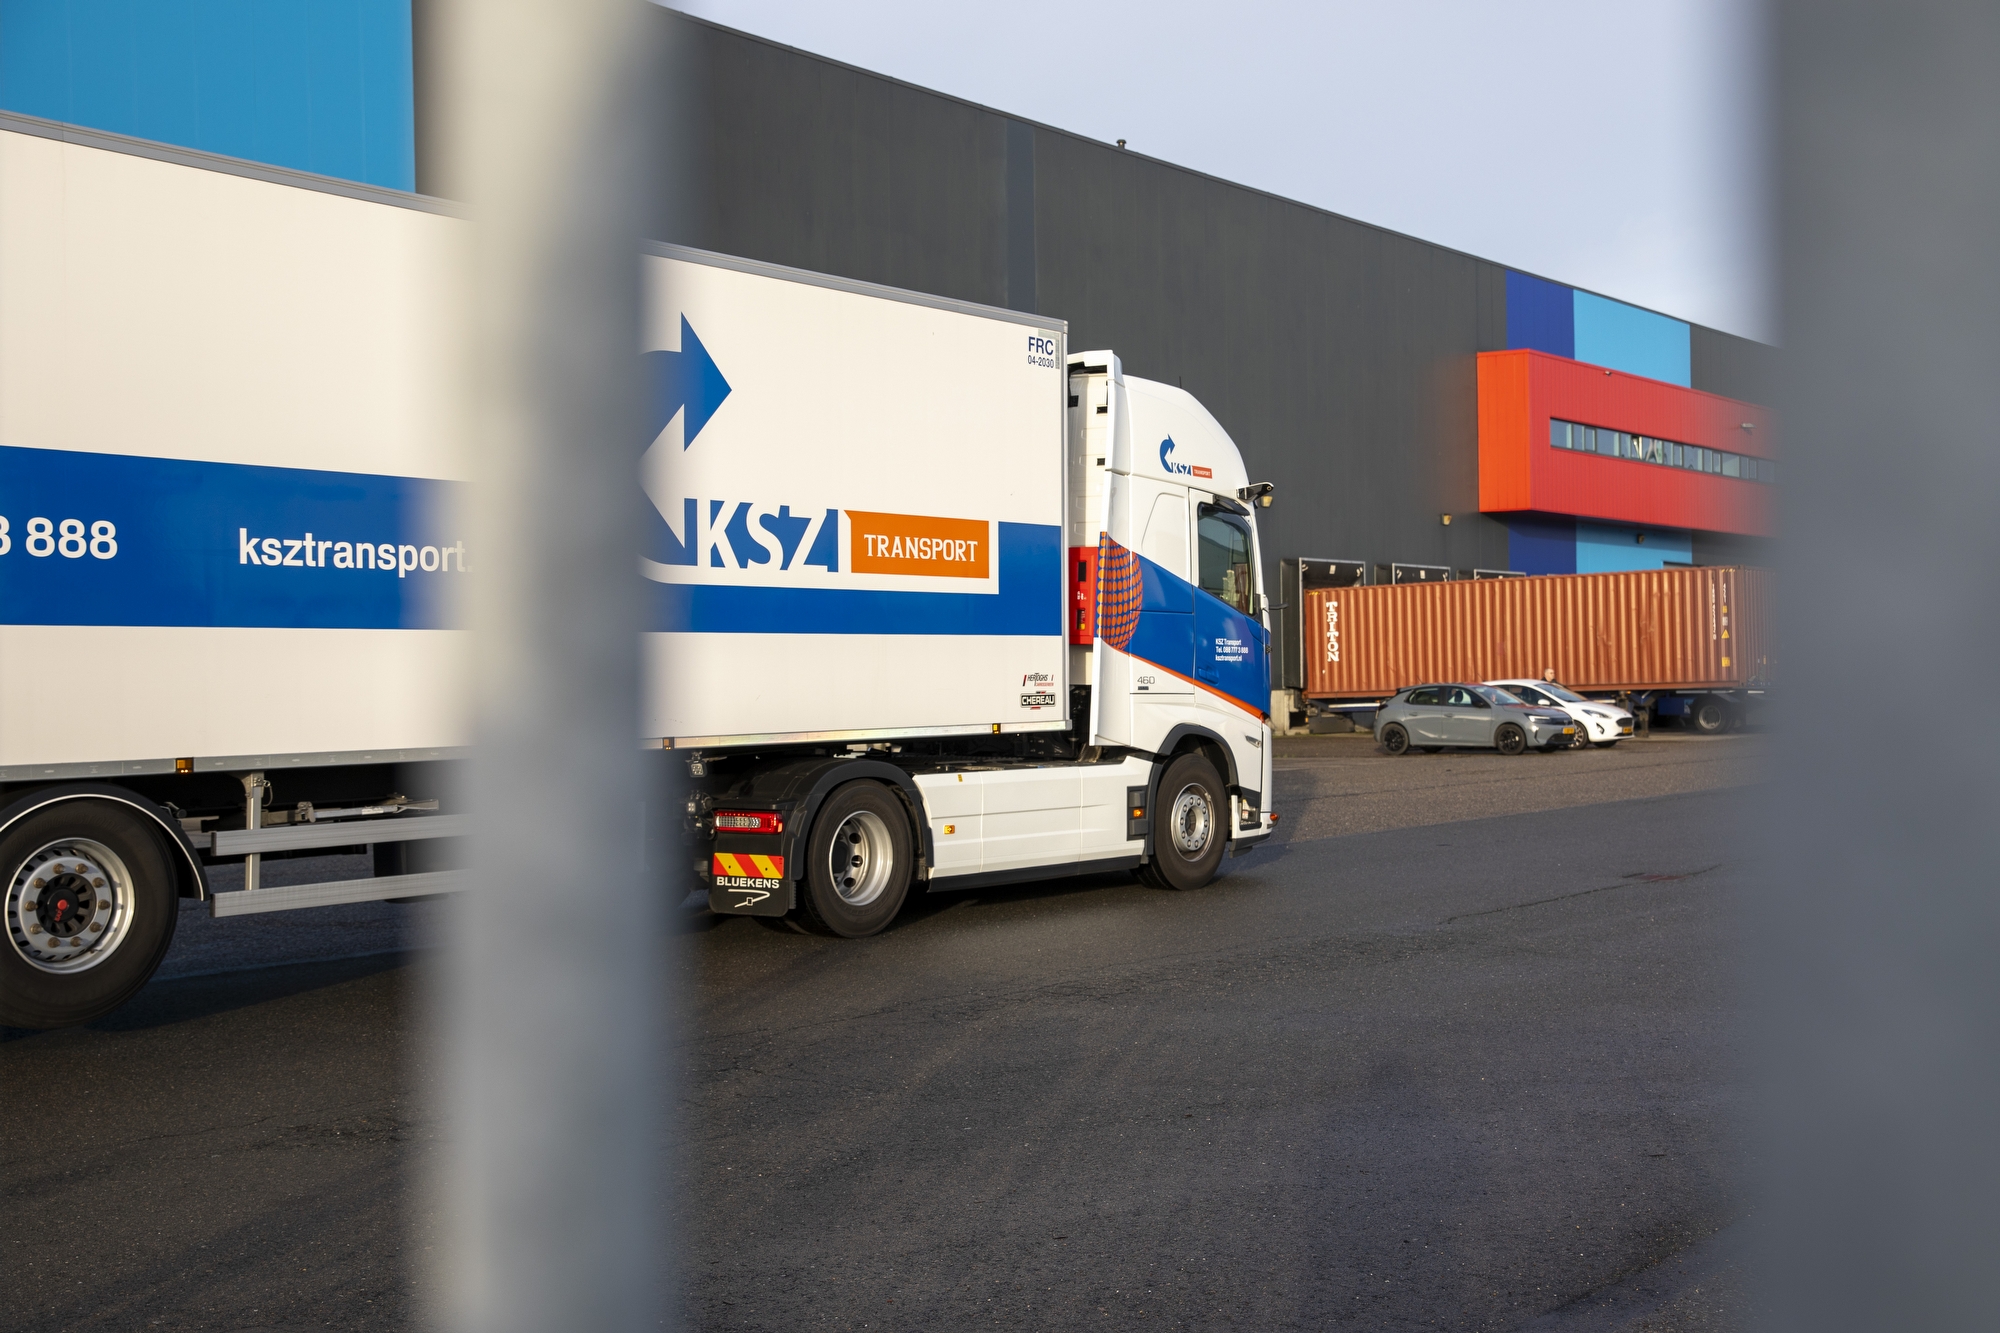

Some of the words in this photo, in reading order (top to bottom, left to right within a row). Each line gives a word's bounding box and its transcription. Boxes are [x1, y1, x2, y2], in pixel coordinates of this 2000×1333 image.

[1028, 336, 1054, 355] FRC
[1028, 355, 1054, 368] 04-2030
[25, 516, 118, 560] 888
[697, 498, 828, 573] KSZ
[863, 533, 979, 563] TRANSPORT
[1325, 601, 1340, 662] TRITON
[1137, 675, 1156, 685] 460
[1022, 695, 1055, 705] CHEREAU
[716, 876, 780, 889] BLUEKENS
